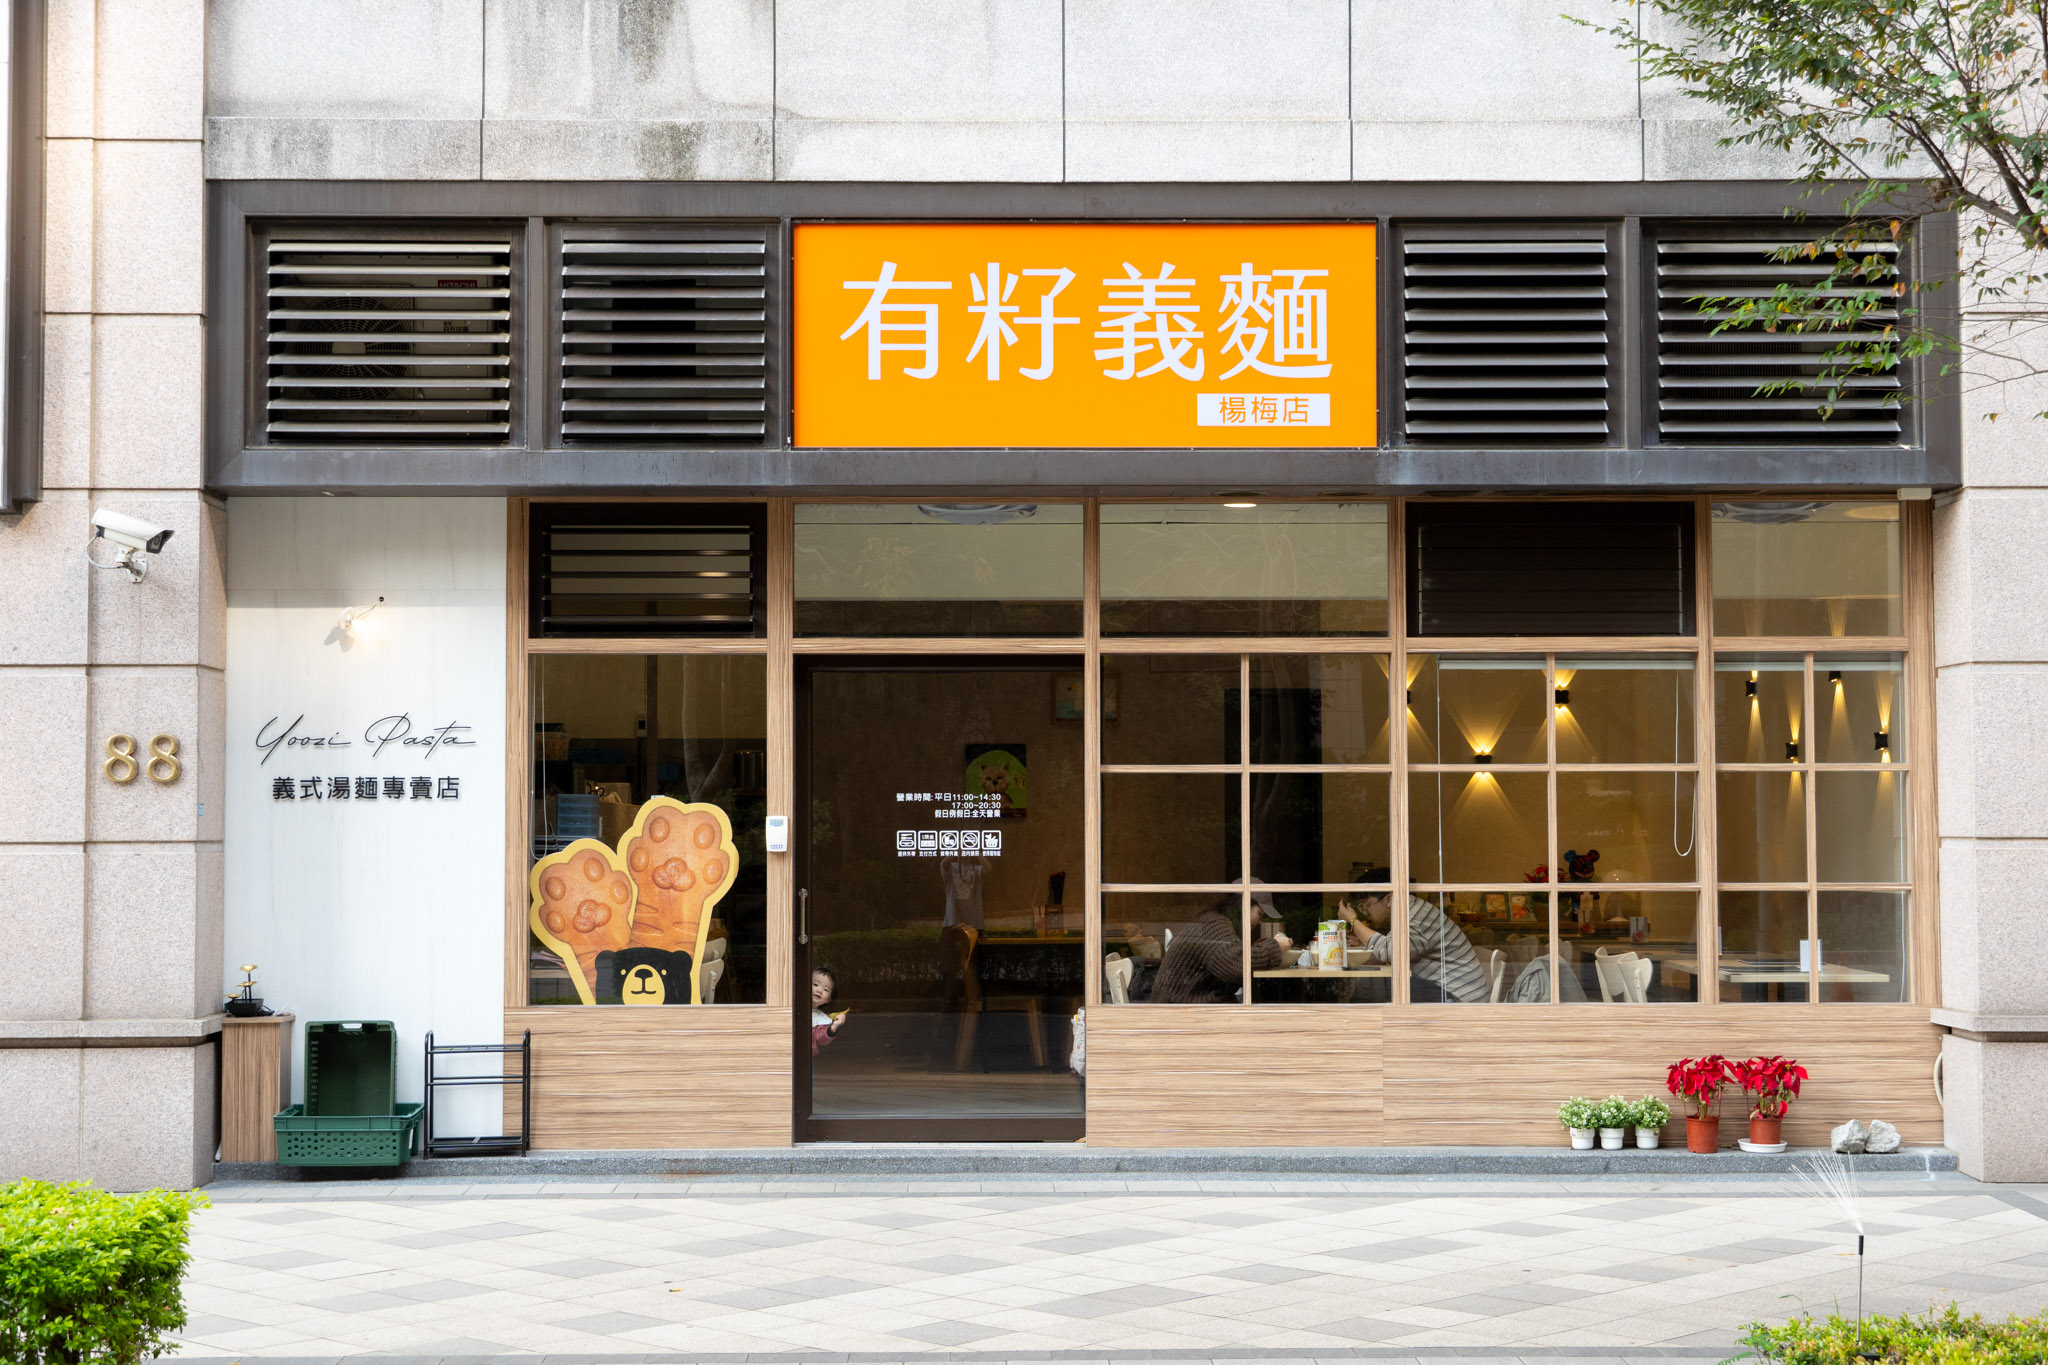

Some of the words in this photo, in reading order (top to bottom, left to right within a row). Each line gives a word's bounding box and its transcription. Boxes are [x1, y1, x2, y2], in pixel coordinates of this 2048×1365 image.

[840, 261, 1333, 382] 有籽義麵
[1219, 396, 1309, 424] 楊梅店
[256, 715, 351, 766] Yoozi
[364, 712, 476, 760] Pasta
[104, 735, 180, 783] 88
[272, 775, 460, 801] 義式湯麵專賣店
[951, 801, 1002, 809] 17:00~20:30
